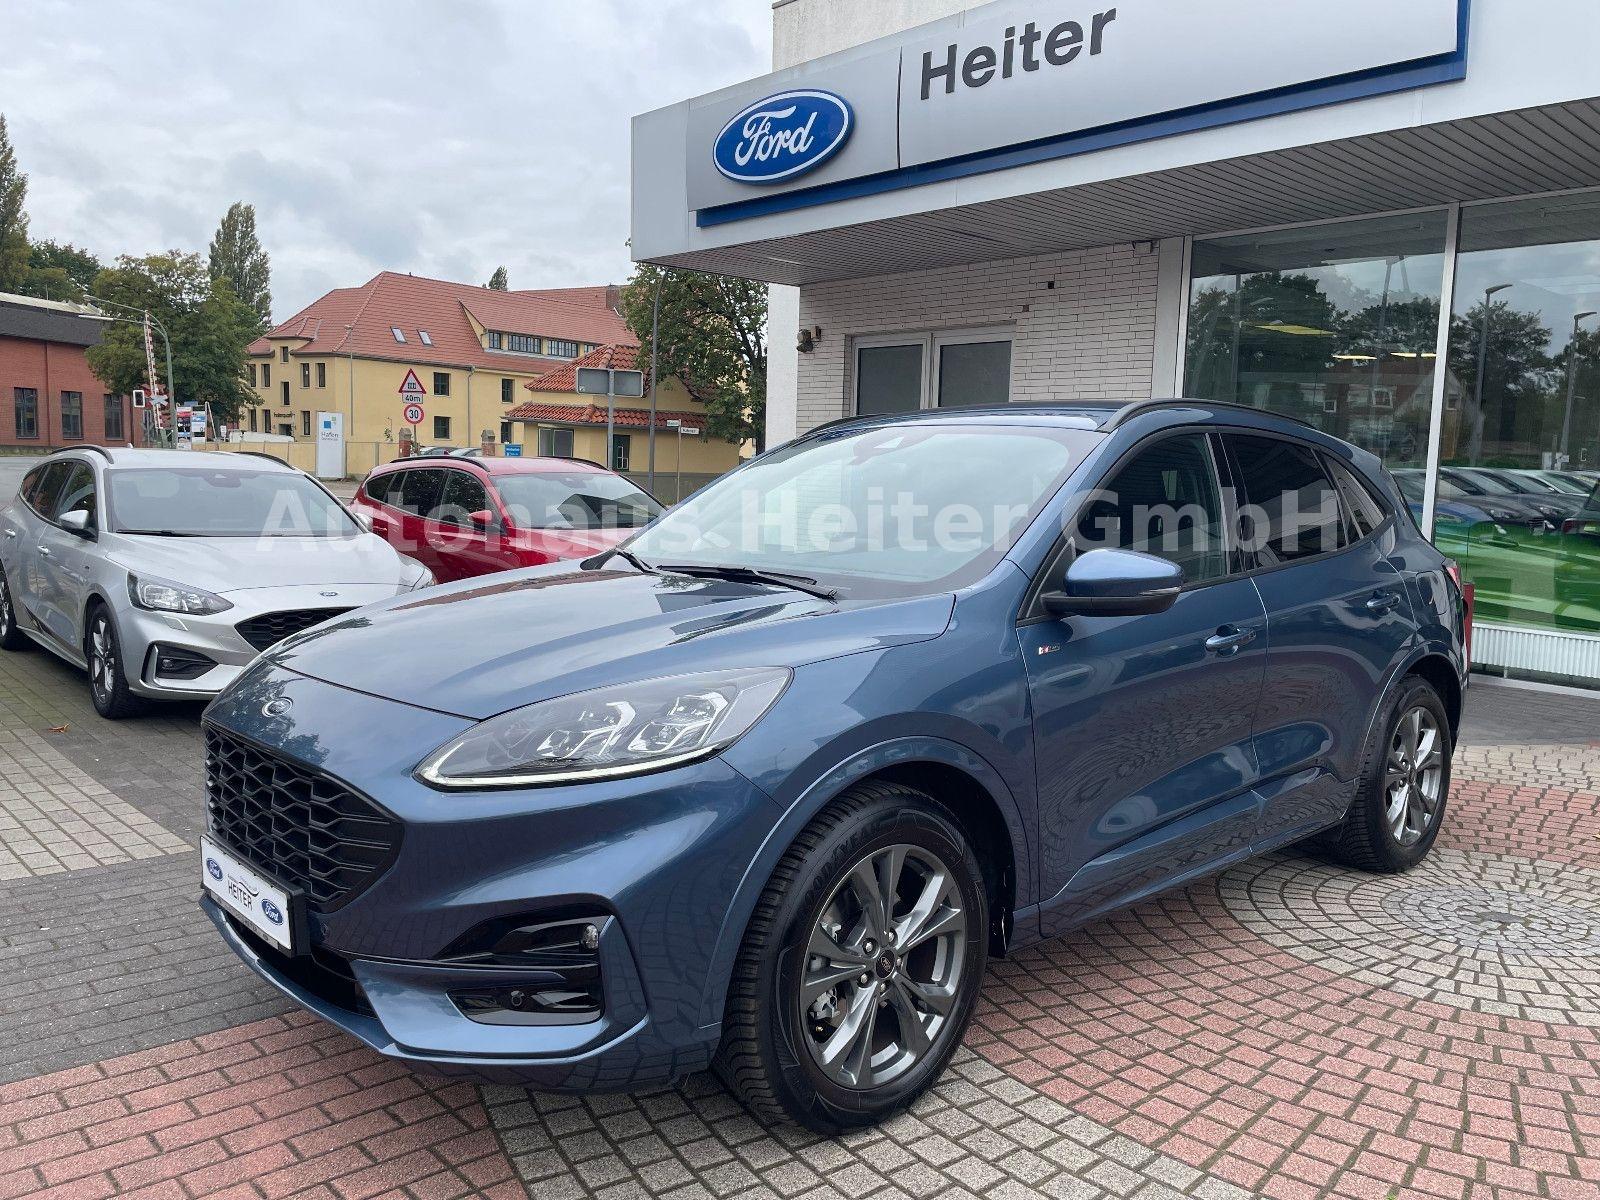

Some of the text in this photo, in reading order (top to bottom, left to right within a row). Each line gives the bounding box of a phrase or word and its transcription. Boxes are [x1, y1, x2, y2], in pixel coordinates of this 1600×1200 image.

[920, 8, 1117, 101] Heiter
[734, 105, 818, 167] Ford
[408, 409, 419, 419] 30
[228, 883, 253, 911] HEITER
